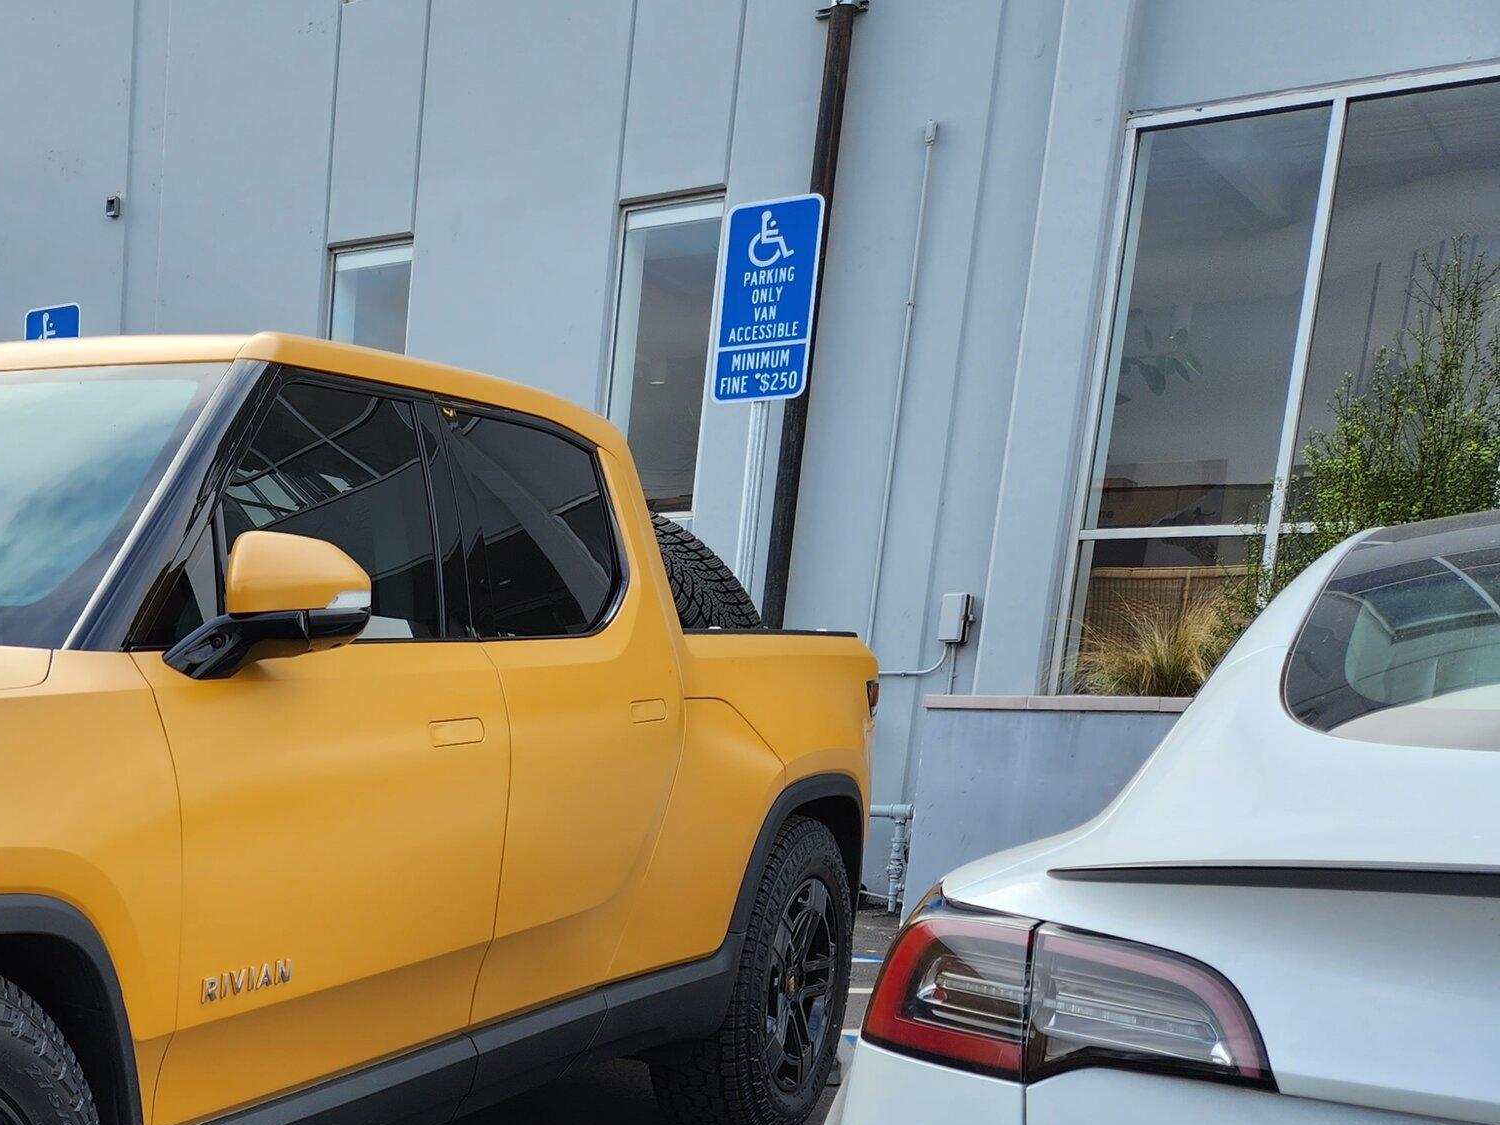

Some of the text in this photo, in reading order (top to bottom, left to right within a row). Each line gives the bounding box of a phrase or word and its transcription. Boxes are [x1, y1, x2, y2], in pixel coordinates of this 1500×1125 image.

[743, 267, 795, 287] PARKING
[751, 286, 783, 304] ONLY
[754, 305, 777, 322] VAN
[728, 321, 799, 343] ACCESSIBLE
[731, 349, 790, 372] MINIMUM
[719, 371, 798, 395] FINE $250
[201, 958, 292, 1004] RIVIAN
